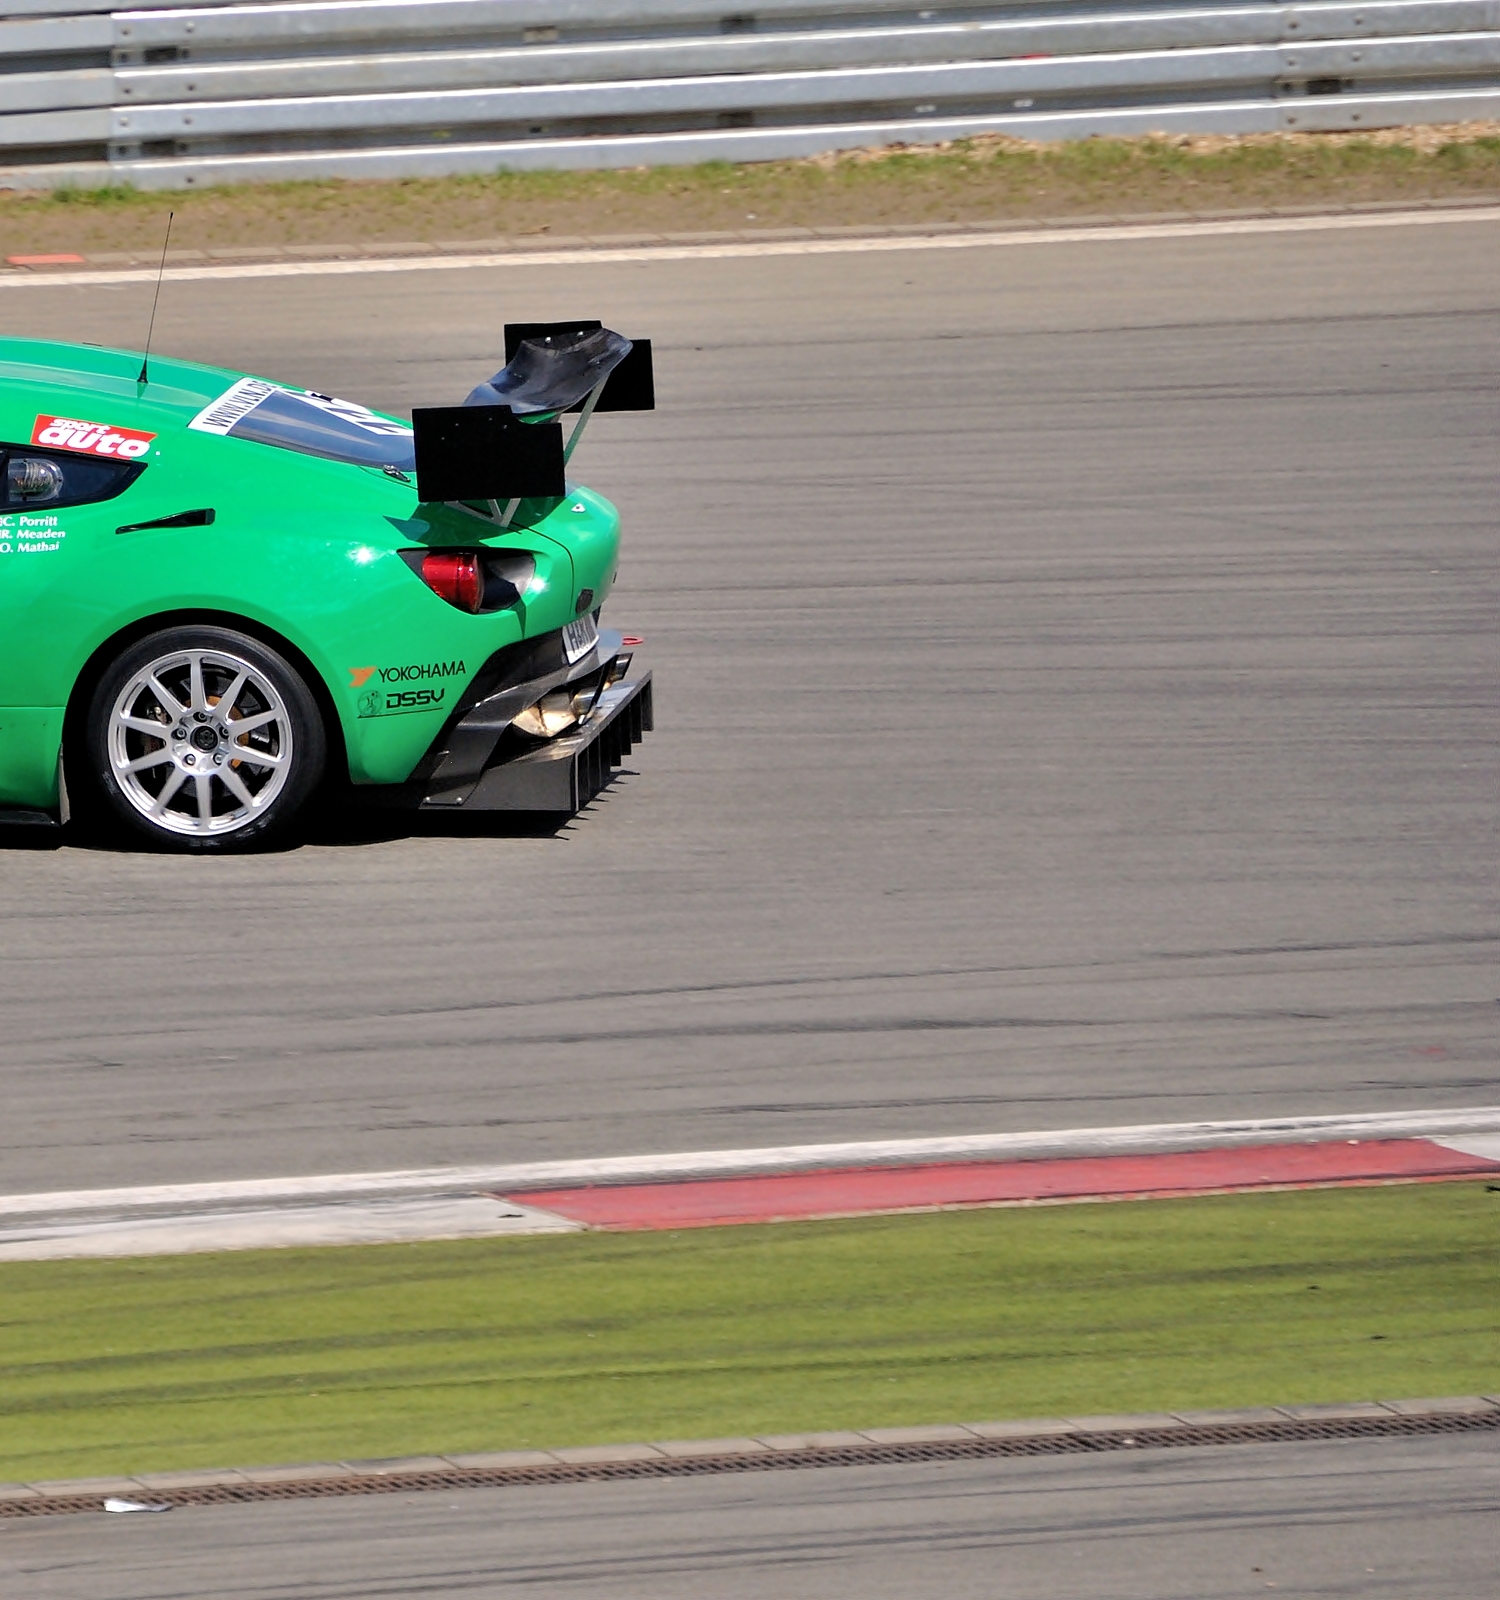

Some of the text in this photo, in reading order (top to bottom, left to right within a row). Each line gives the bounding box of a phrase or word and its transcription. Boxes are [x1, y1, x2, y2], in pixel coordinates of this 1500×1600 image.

[49, 418, 111, 435] sport
[38, 427, 151, 457] auto
[2, 515, 58, 527] C. Porritt
[1, 528, 66, 539] R. Meaden
[17, 541, 60, 553] Mathai
[378, 660, 466, 683] YOKOHAMA
[386, 688, 445, 709] DSSV
